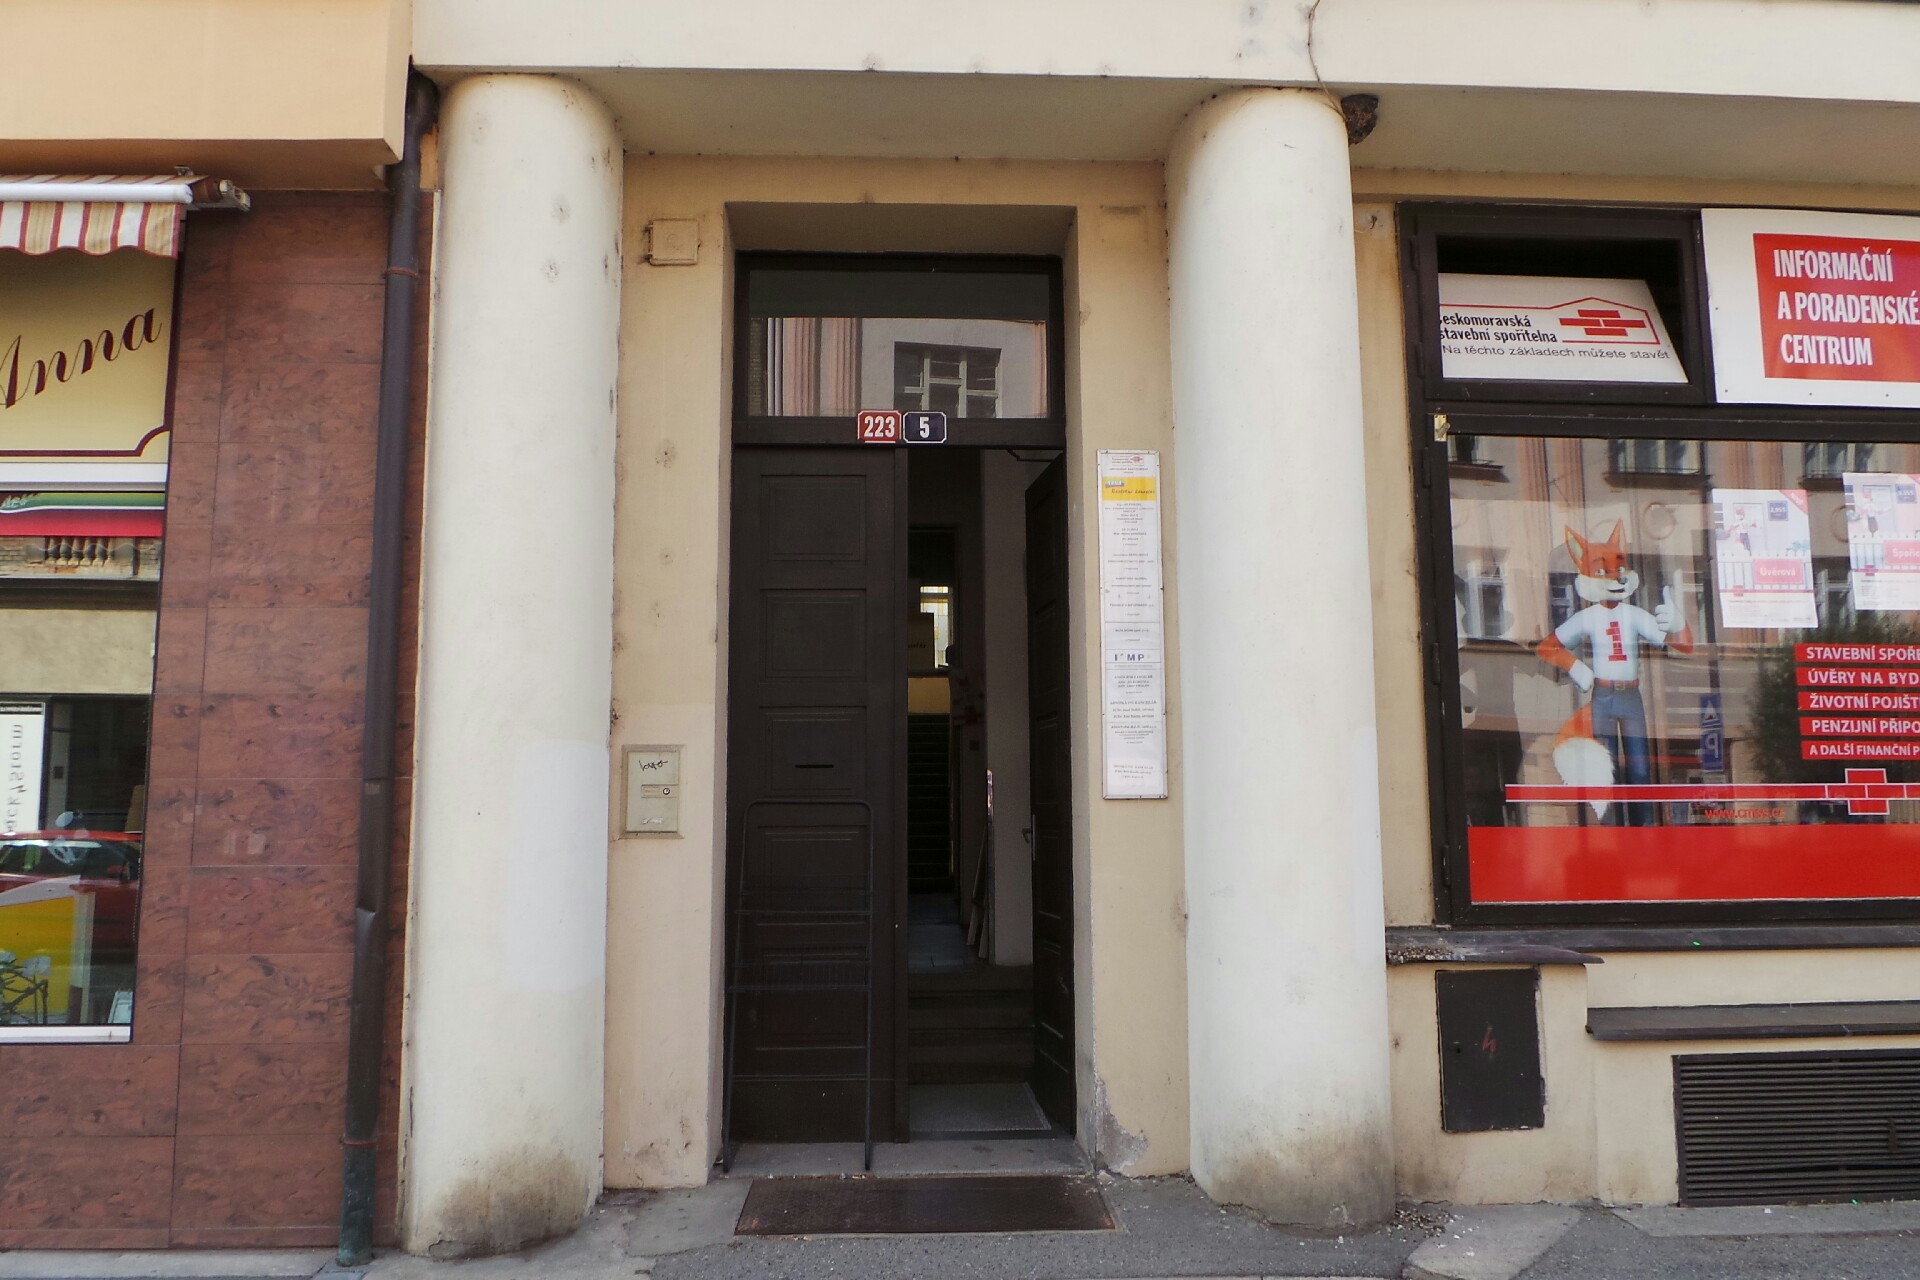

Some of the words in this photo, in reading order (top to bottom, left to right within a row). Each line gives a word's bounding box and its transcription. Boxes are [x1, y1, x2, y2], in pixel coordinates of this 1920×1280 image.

[1773, 246, 1894, 282] INFORMAČNÍ
[1777, 291, 1792, 320] A
[1794, 290, 1920, 325] PORADENSKÉ
[1440, 313, 1531, 327] eskomoravská
[1494, 329, 1558, 343] spořitelna
[1443, 345, 1461, 354] Na
[1465, 345, 1504, 355] těchto
[1509, 347, 1574, 357] základech
[1579, 348, 1626, 358] můžete
[1780, 333, 1873, 366] CENTRUM
[0, 308, 162, 409] Anna
[864, 416, 895, 437] 223
[919, 417, 930, 438] 5
[1806, 645, 1875, 660] STAVEBNÍ
[1808, 668, 1856, 684] ÚVĚRY
[1861, 672, 1883, 684] NA
[1889, 672, 1920, 685] BYD
[1810, 693, 1868, 708] ŽIVOTNÍ
[1872, 694, 1920, 709] POJIŠT
[1812, 718, 1877, 733] PENZIJNÍ
[1880, 718, 1920, 733] PŘIPO
[1809, 745, 1818, 755] A
[1820, 743, 1854, 755] DALŠÍ
[1857, 744, 1911, 756] FINANČNÍ
